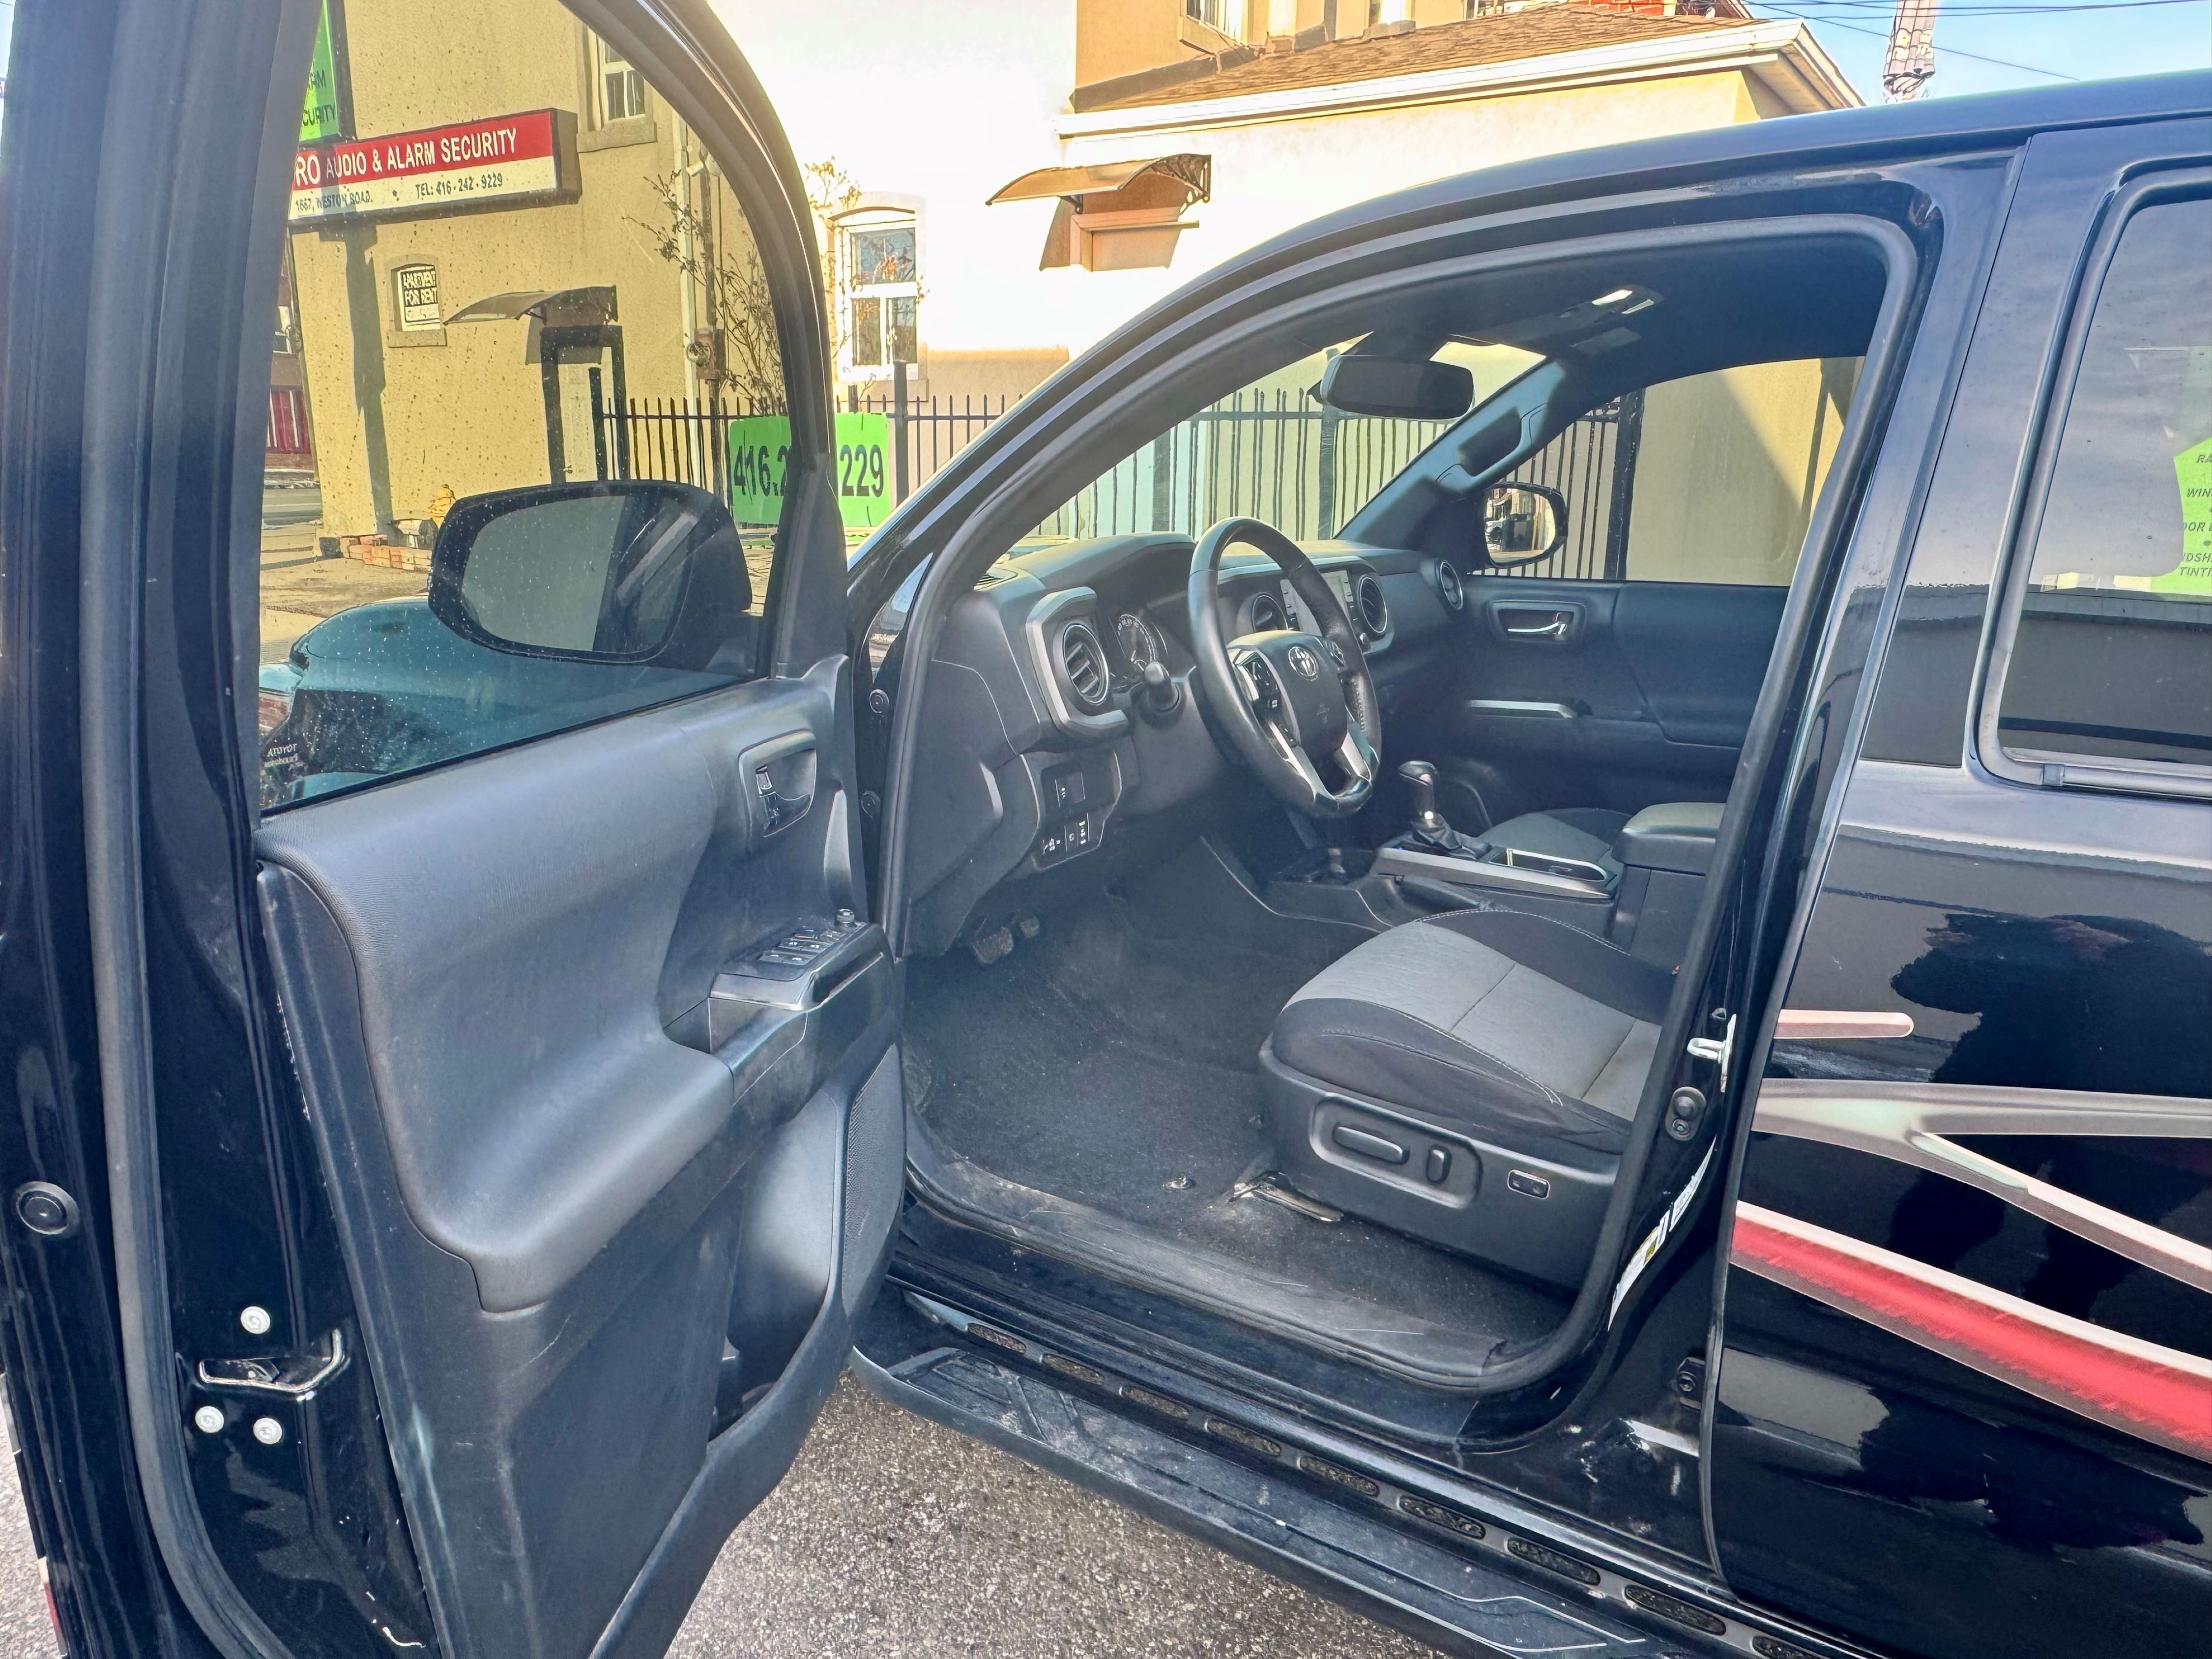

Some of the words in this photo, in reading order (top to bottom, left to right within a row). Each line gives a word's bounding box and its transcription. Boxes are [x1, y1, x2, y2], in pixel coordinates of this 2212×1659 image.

[295, 155, 320, 187] RO
[326, 151, 367, 179] AUDIO
[372, 149, 382, 172] &
[387, 141, 436, 171] ALARM
[440, 128, 516, 163] SECURITY
